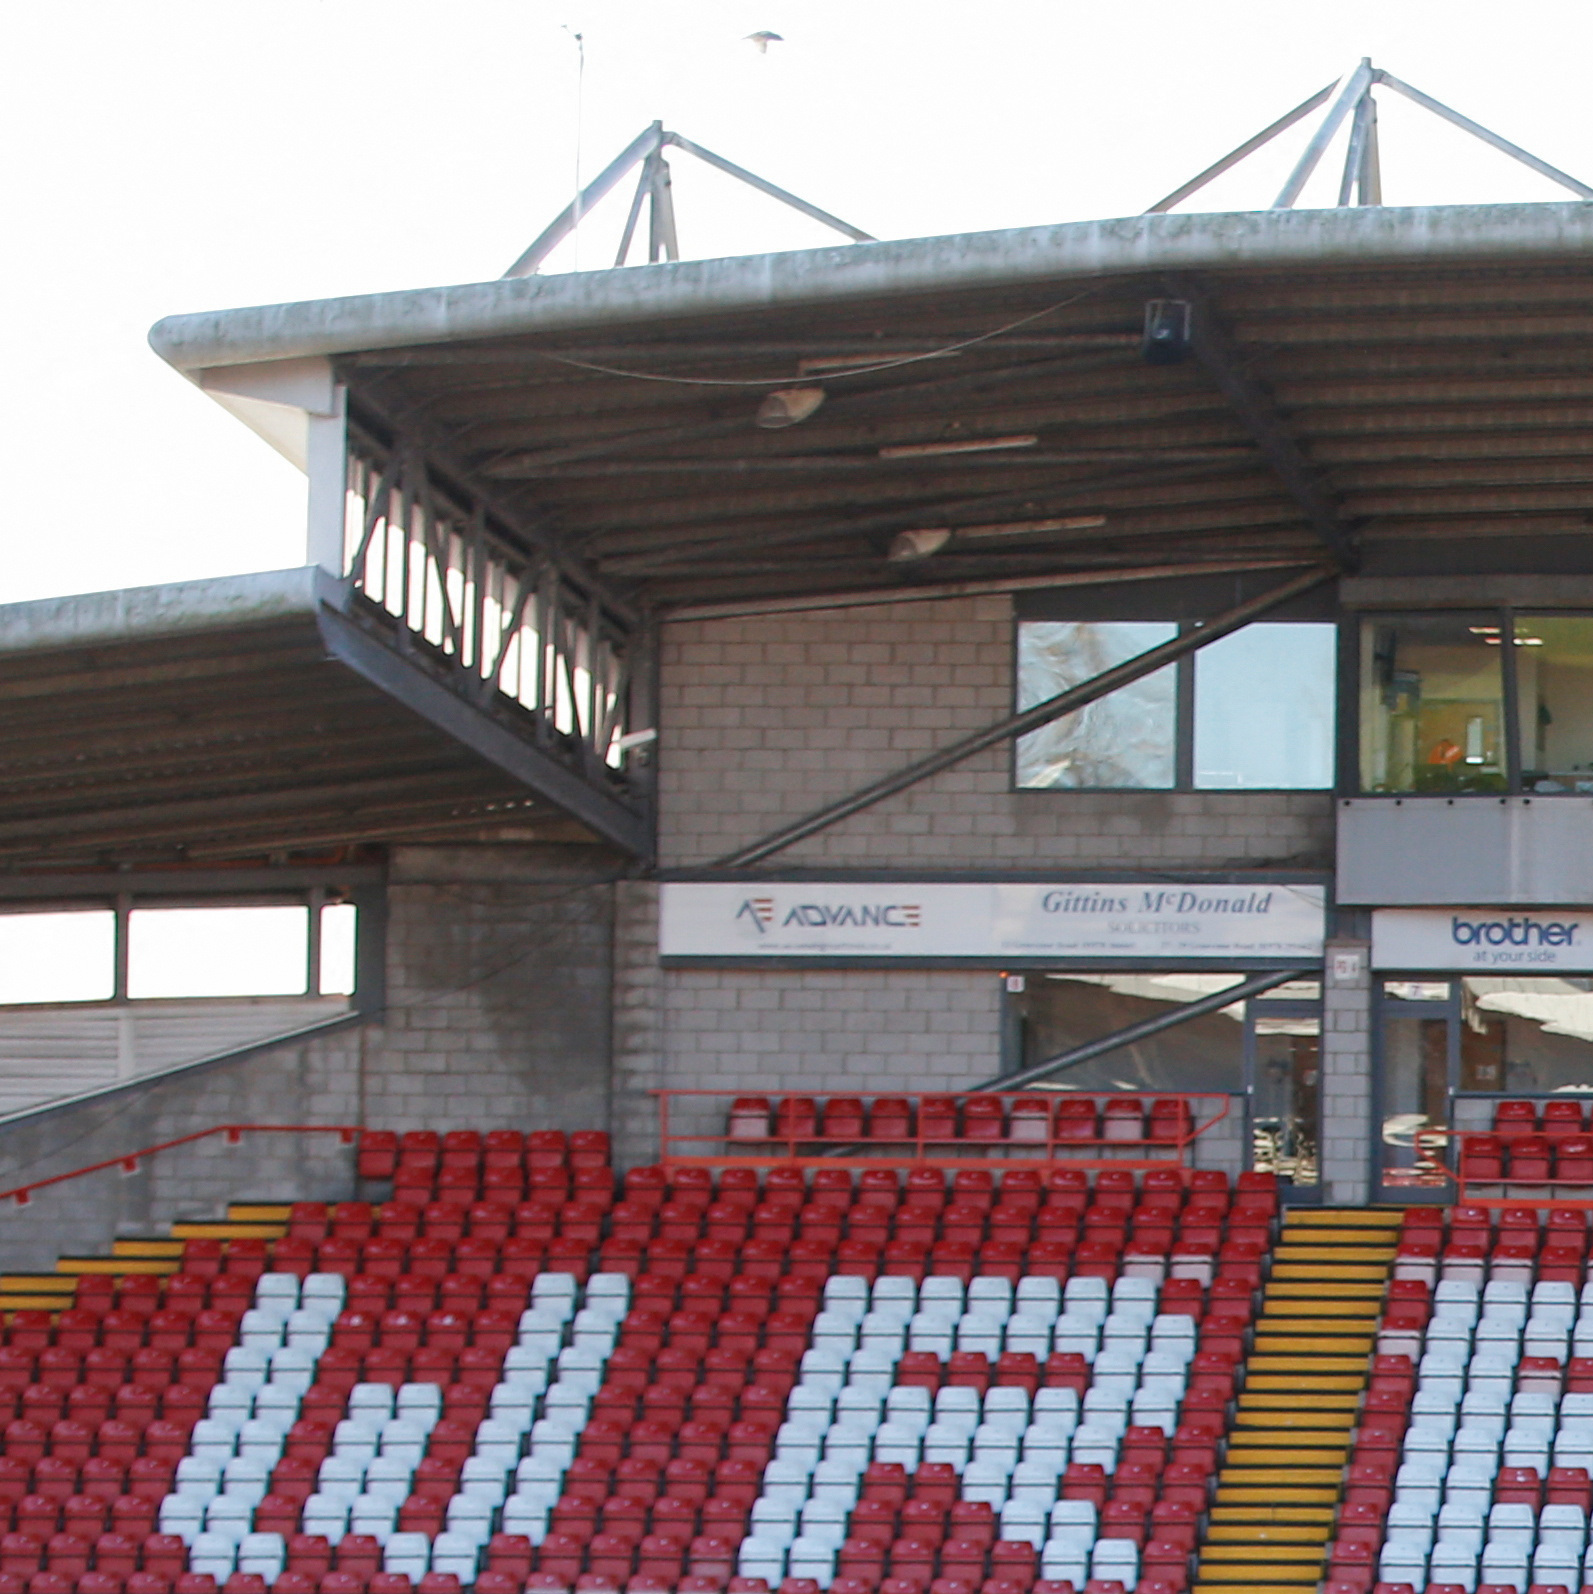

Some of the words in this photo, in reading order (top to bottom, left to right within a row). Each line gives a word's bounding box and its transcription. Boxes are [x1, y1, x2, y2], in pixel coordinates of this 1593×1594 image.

[1042, 891, 1128, 914] Gittins
[1138, 891, 1272, 914] McDonald
[783, 905, 920, 926] ADVANCE
[1107, 921, 1201, 934] SOLICITORS
[1452, 917, 1579, 946] brother
[1473, 951, 1488, 962] at
[1491, 952, 1524, 964] your
[1527, 950, 1557, 962] side
